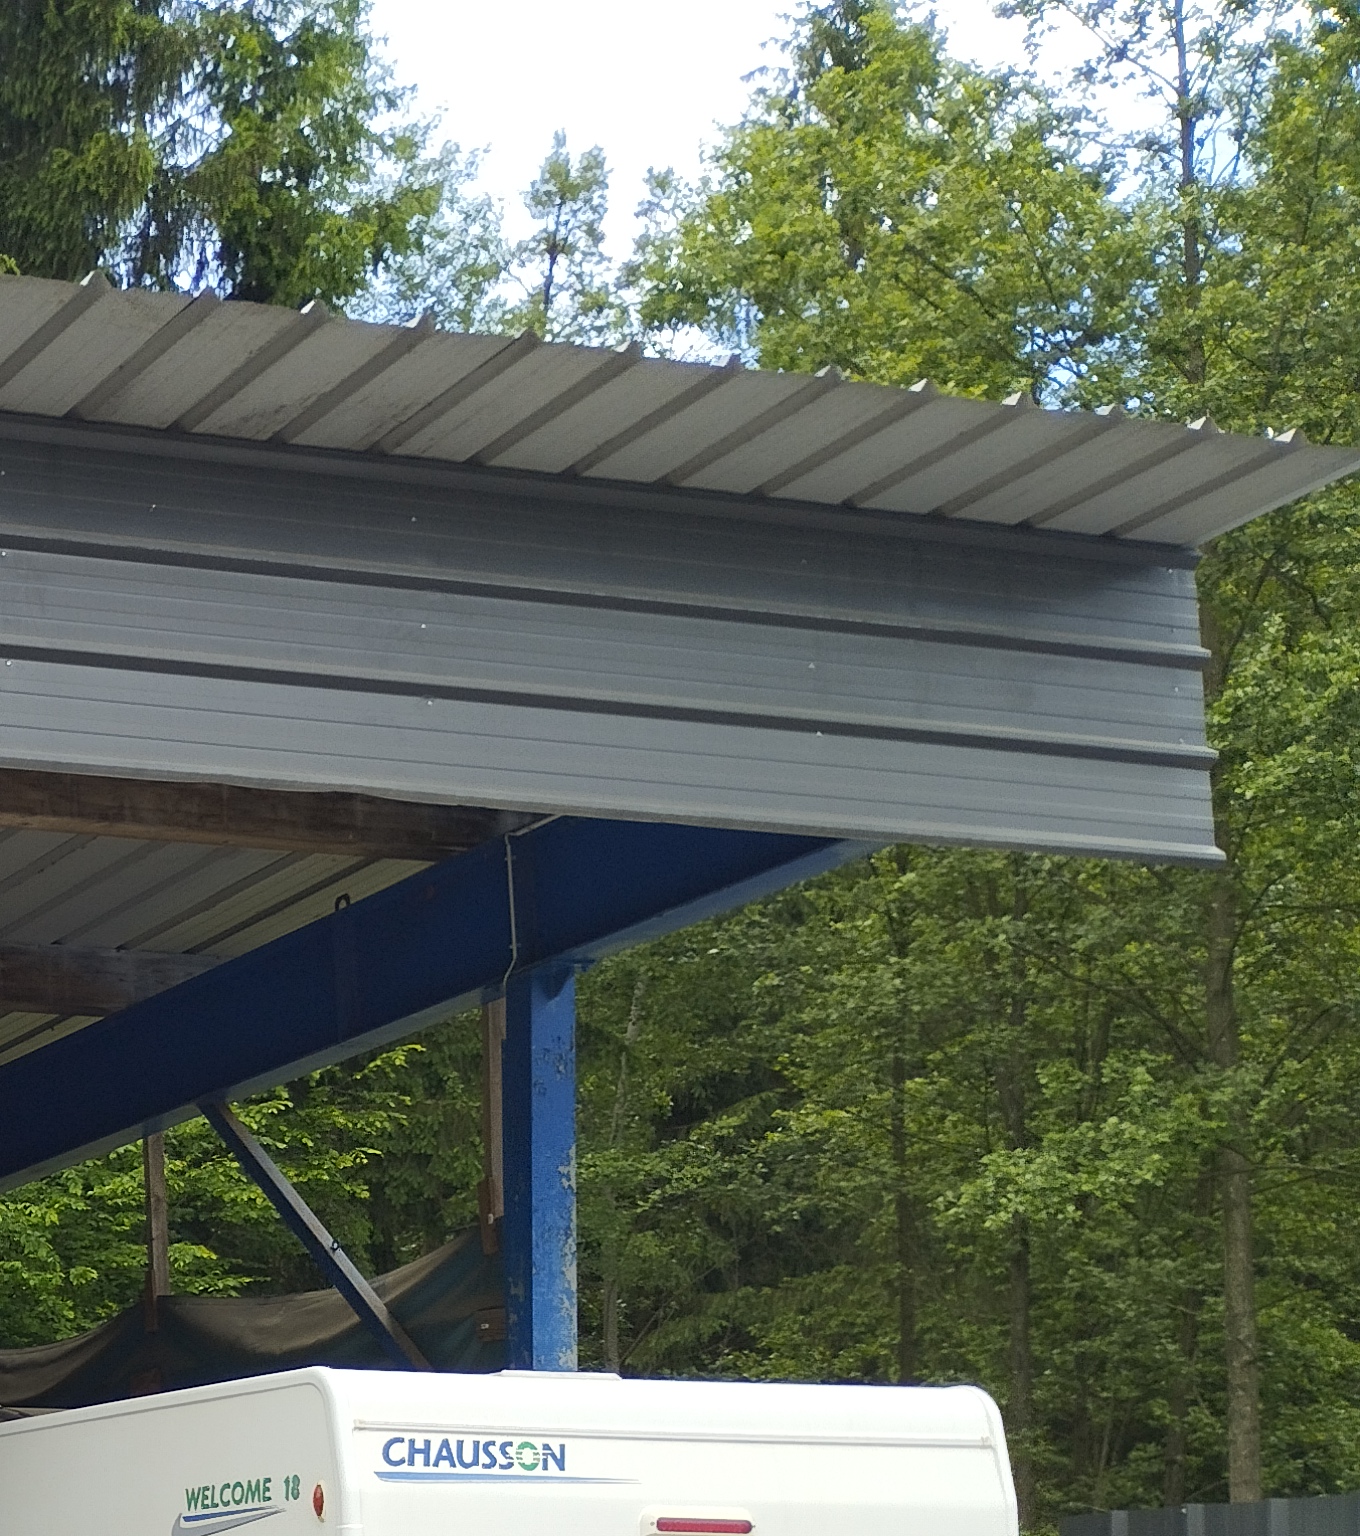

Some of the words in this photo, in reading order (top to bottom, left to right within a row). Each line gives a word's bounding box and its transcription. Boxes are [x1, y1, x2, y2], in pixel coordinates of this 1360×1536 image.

[382, 1437, 566, 1471] CHAUSSON
[185, 1477, 272, 1512] WELCOME
[283, 1474, 301, 1501] 18
